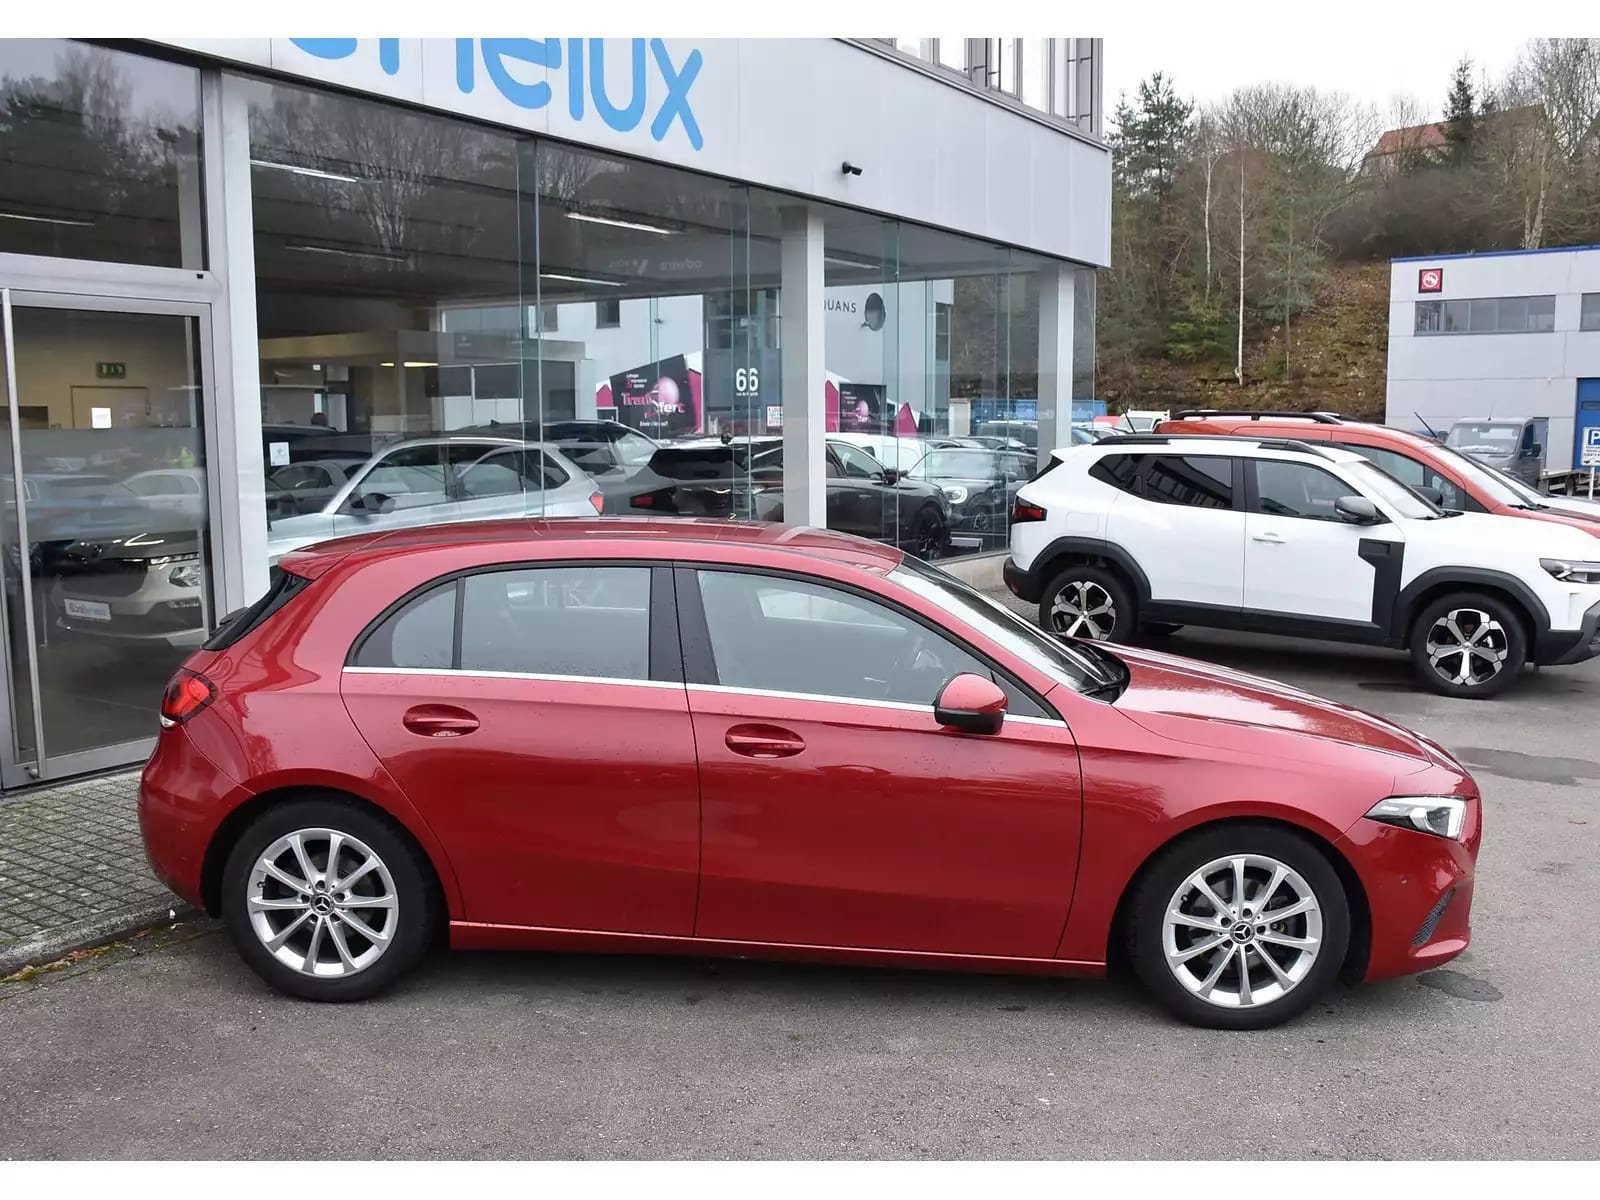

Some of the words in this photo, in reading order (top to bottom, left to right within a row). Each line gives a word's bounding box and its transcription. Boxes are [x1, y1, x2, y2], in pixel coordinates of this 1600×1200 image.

[288, 38, 704, 151] elux
[824, 299, 857, 313] UANS
[736, 367, 759, 392] 66
[1590, 430, 1600, 445] P
